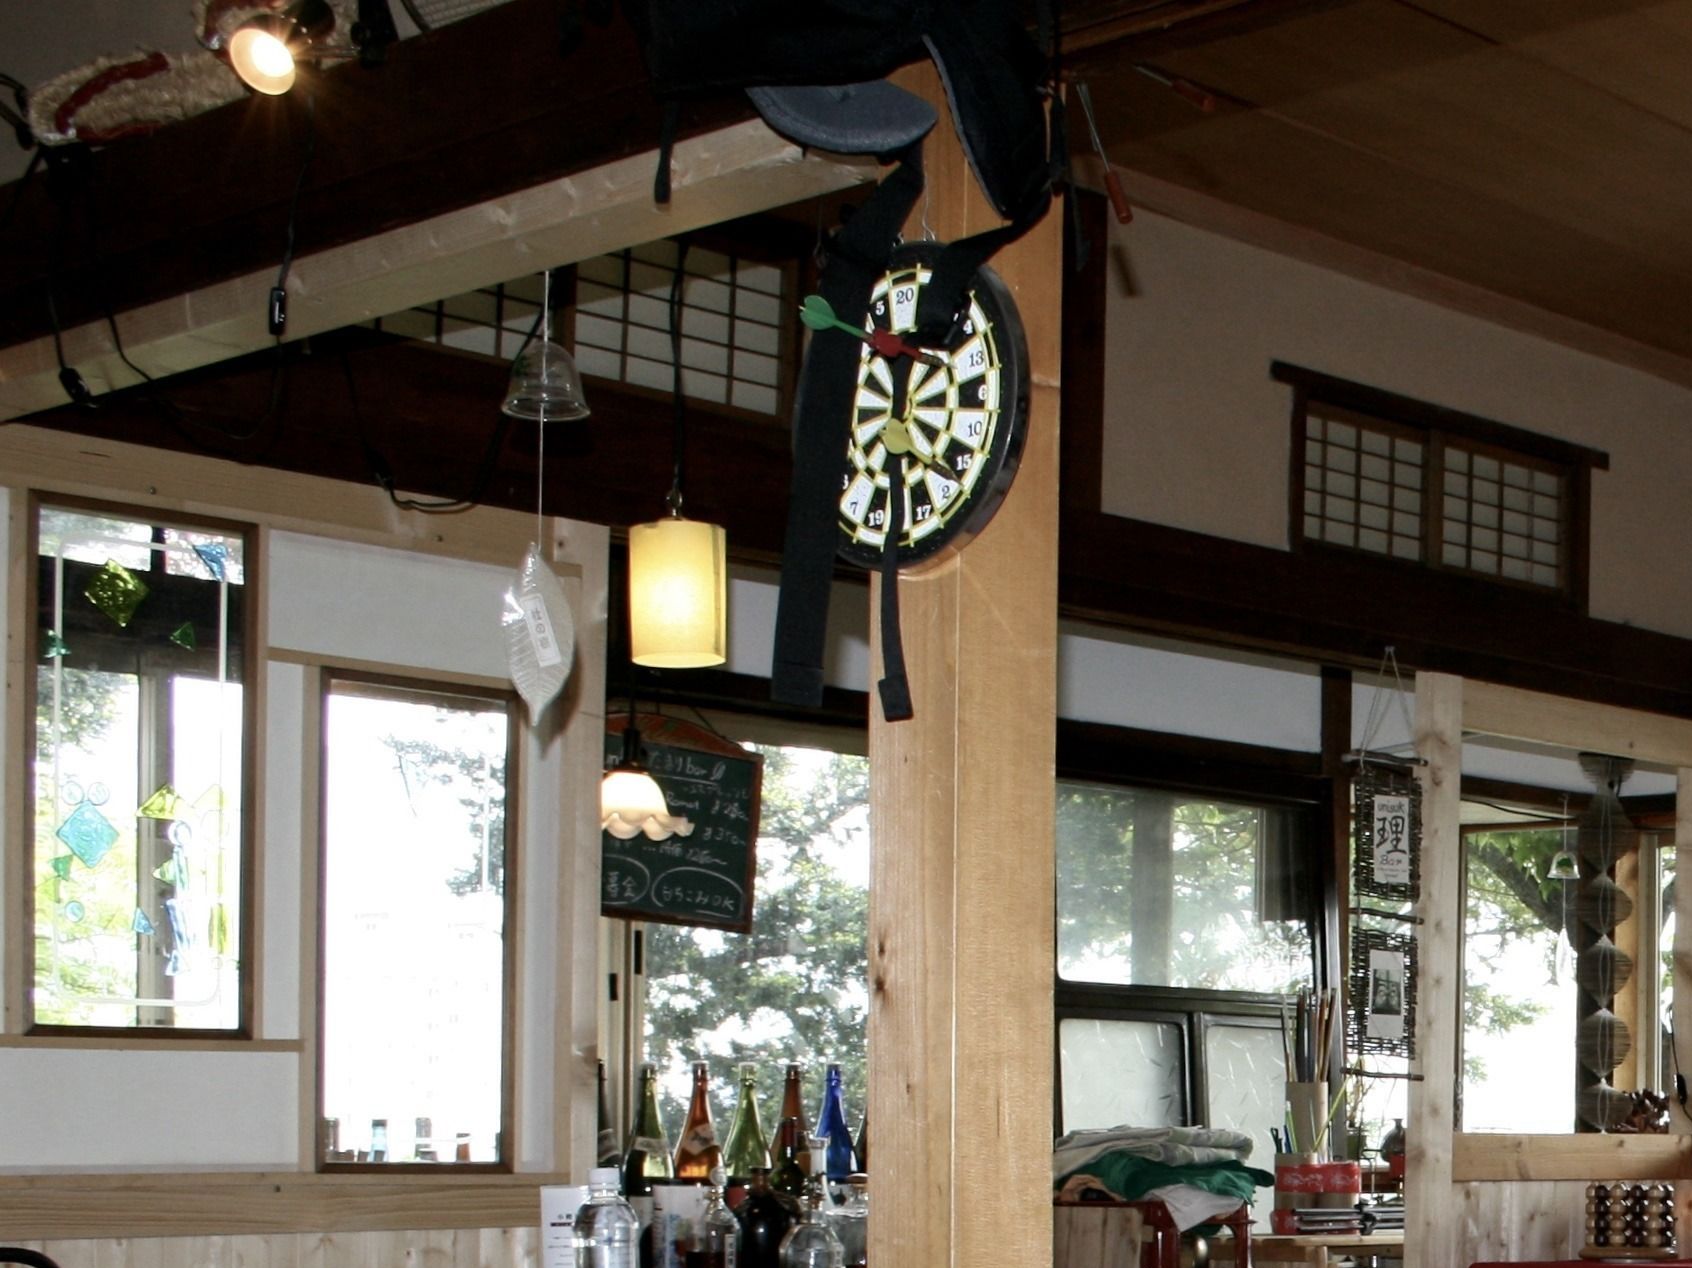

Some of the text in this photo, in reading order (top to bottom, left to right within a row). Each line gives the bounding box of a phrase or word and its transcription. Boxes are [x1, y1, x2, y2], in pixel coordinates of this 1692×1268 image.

[896, 287, 914, 304] 20
[875, 300, 885, 316] 5
[962, 319, 973, 335] 4
[968, 350, 984, 367] 13
[977, 384, 988, 401] 6
[968, 420, 983, 438] 10
[956, 453, 972, 471] 15
[941, 485, 951, 499] 2
[850, 501, 858, 516] 7
[916, 504, 932, 521] 17
[867, 509, 884, 527] 19
[1376, 815, 1407, 855] 理
